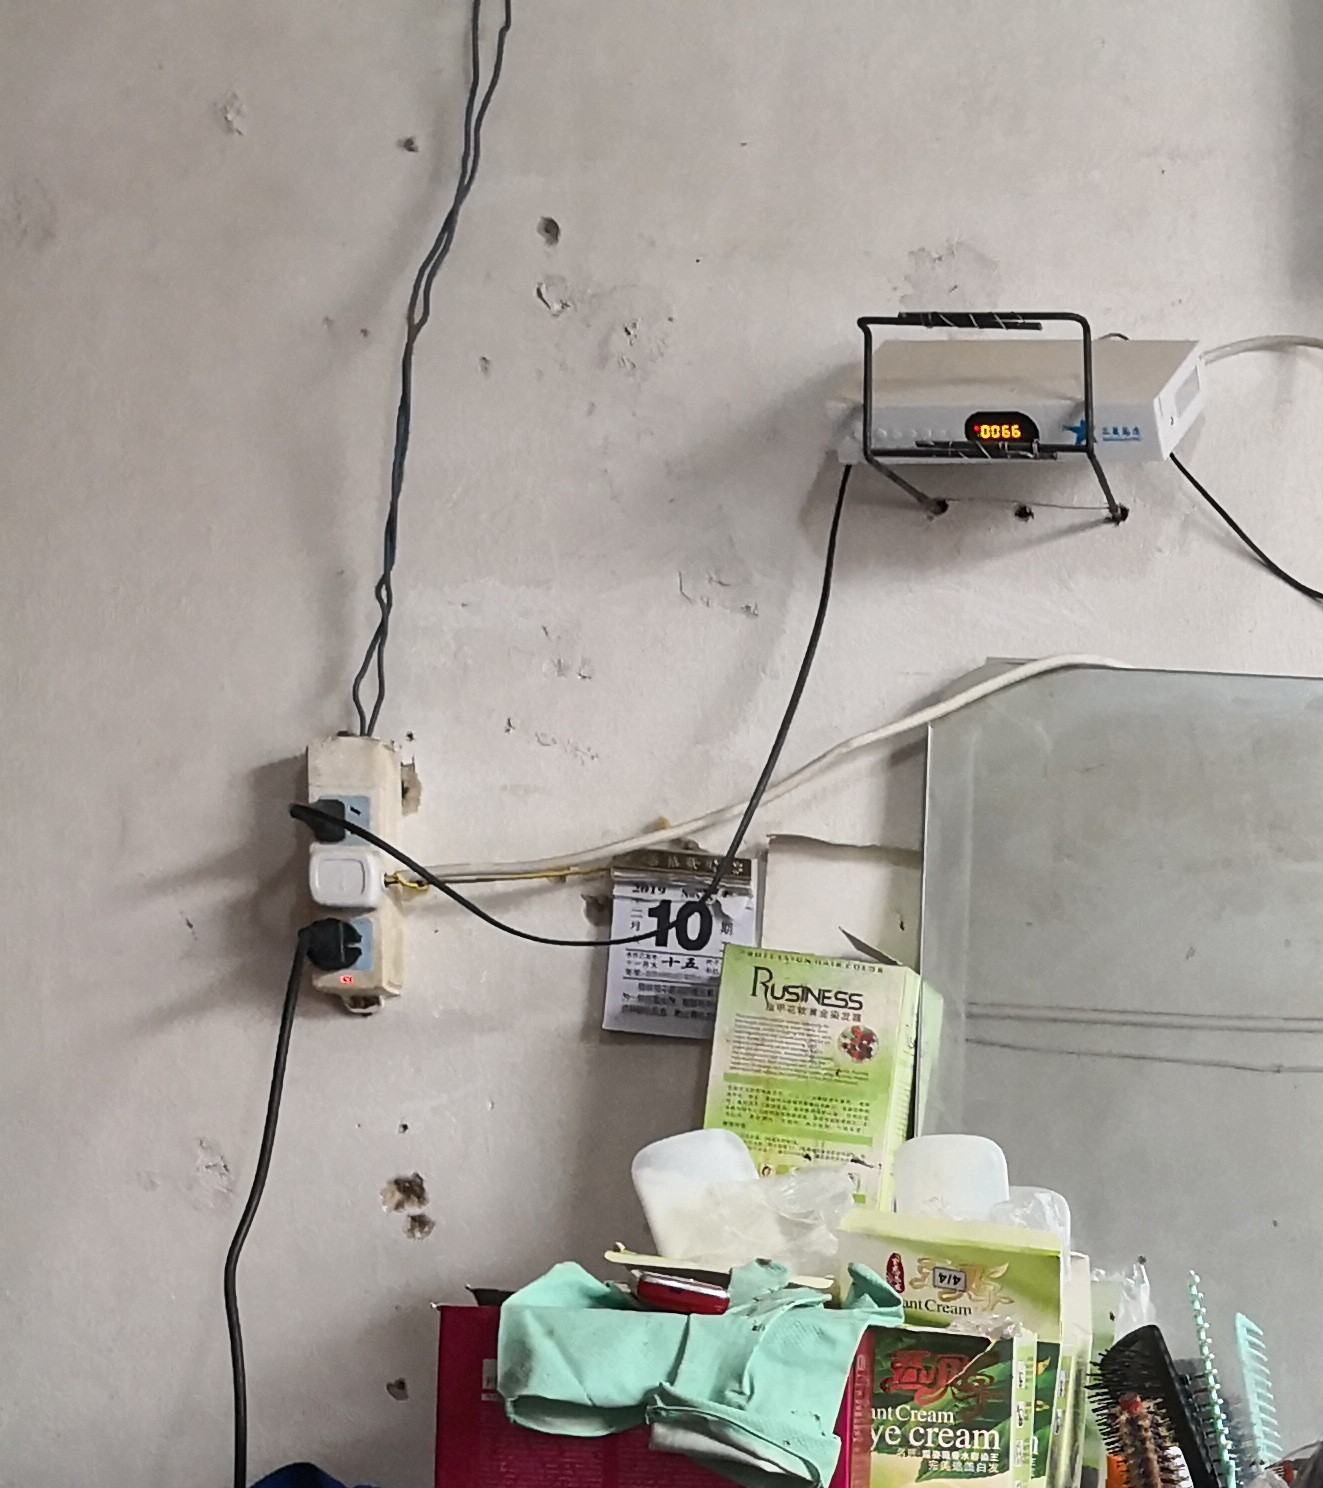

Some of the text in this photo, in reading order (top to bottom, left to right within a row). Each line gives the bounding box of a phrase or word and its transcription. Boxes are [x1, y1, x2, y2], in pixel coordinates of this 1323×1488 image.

[980, 424, 1022, 439] 0066
[632, 882, 666, 895] 2019
[648, 899, 713, 951] 10
[661, 956, 699, 970] 十五
[902, 1298, 972, 1316] ant Cream
[895, 1404, 955, 1424] Cream
[870, 1424, 902, 1451] ye
[908, 1426, 1001, 1450] cream
